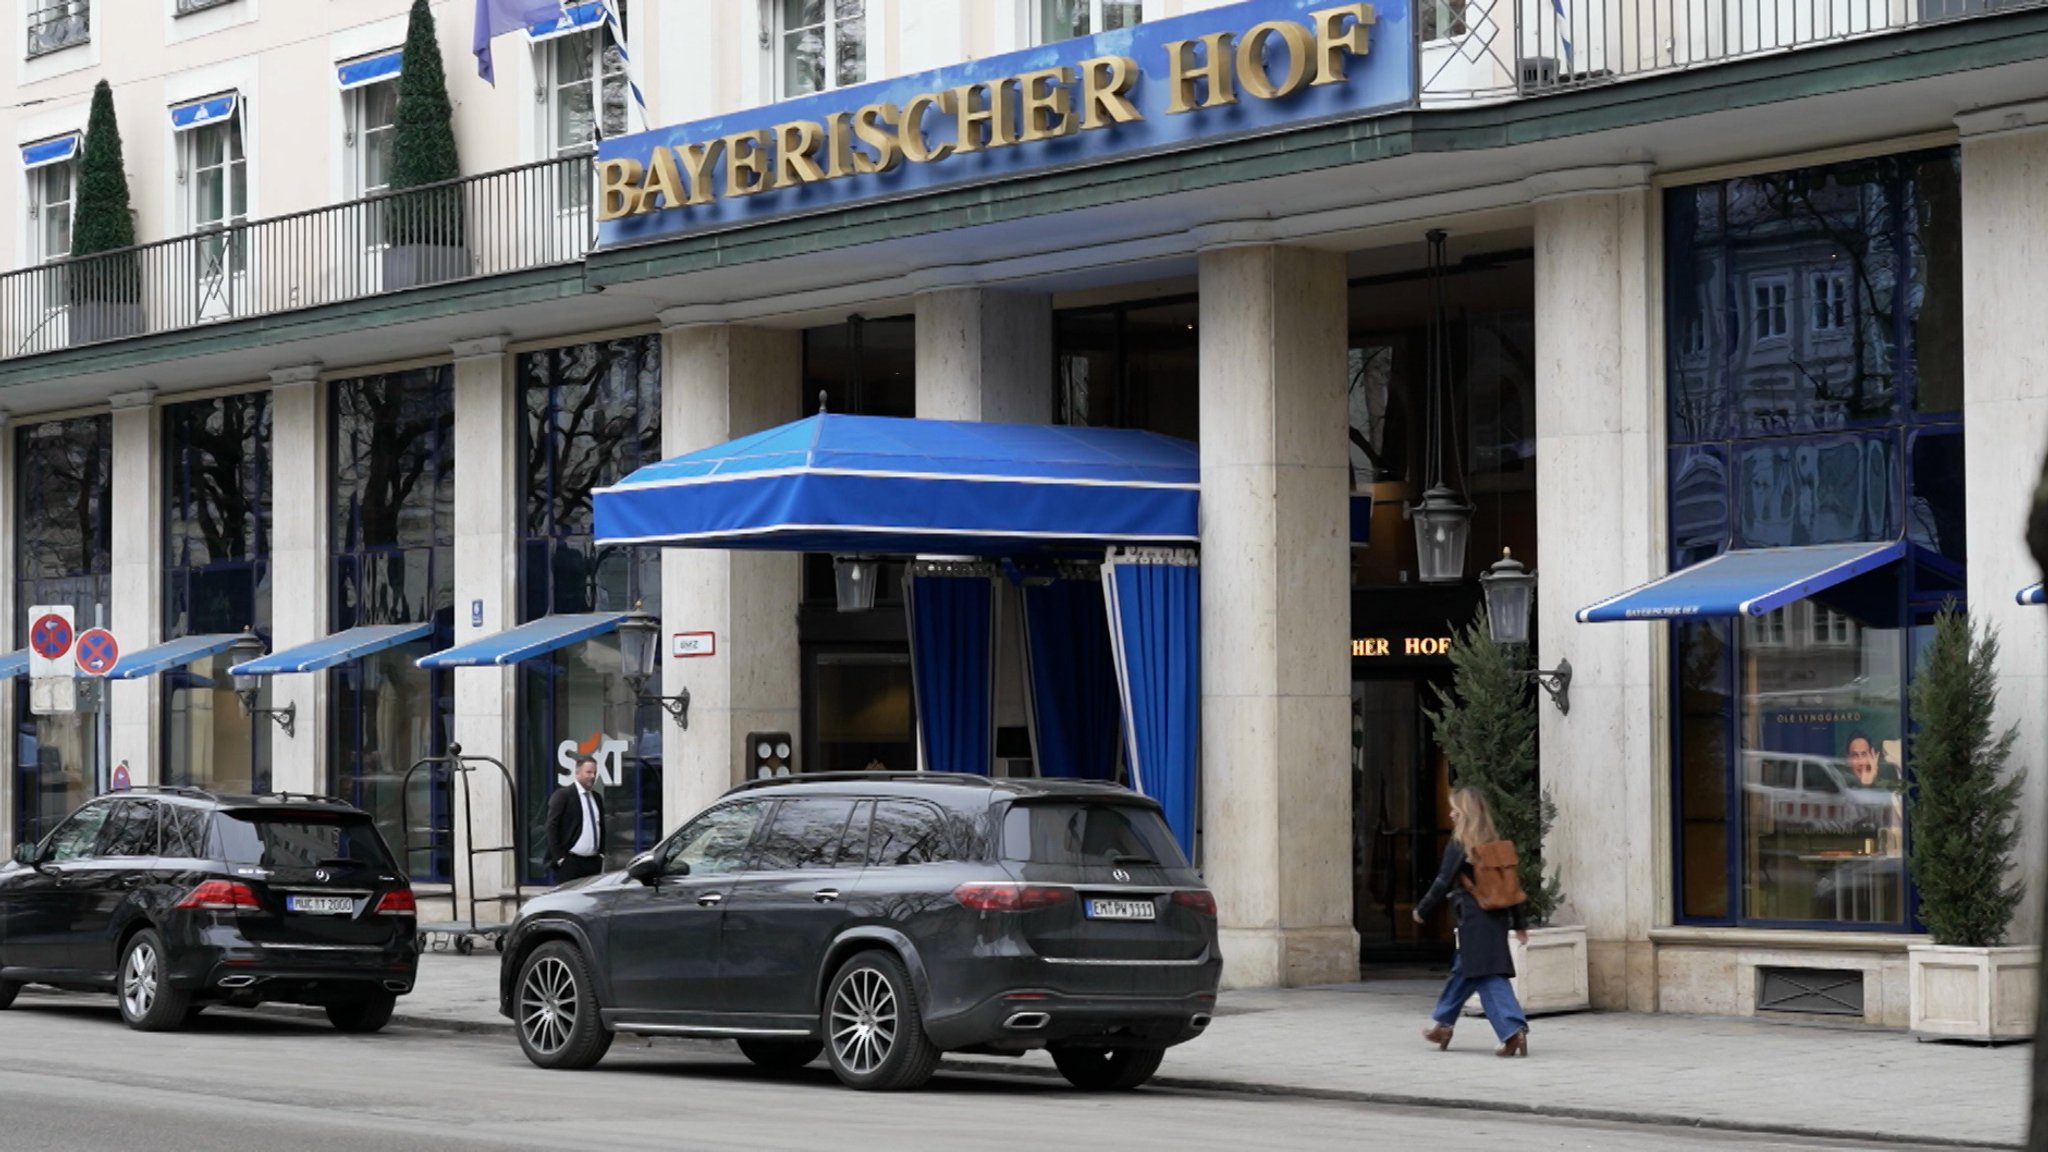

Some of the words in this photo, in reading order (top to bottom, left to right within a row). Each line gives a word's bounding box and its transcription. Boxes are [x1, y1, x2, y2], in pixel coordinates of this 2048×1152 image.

[598, 55, 1145, 221] BAYERISCHER
[1162, 3, 1376, 115] HOF
[1404, 637, 1452, 655] HOF
[1776, 713, 1795, 723] OLE
